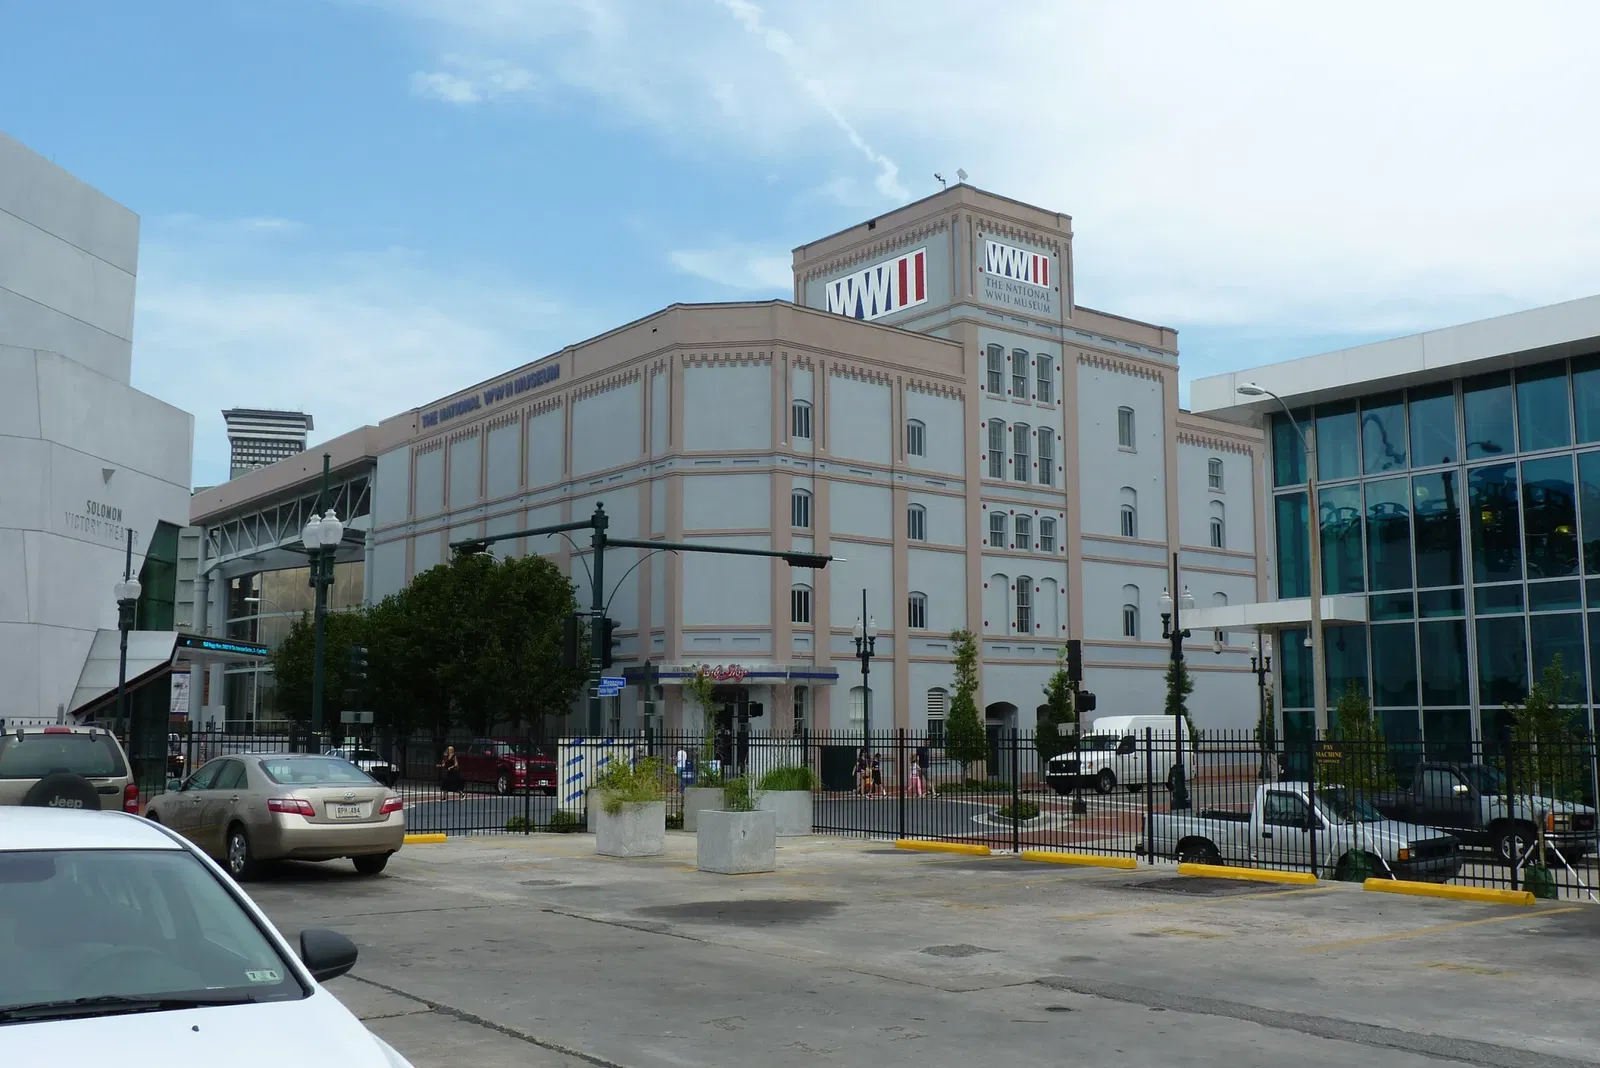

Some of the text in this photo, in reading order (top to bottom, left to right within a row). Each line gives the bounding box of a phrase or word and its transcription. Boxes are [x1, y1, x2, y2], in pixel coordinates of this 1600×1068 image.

[986, 243, 1049, 287] WWII
[827, 251, 926, 319] WWII
[985, 278, 1051, 302] THE NATIONAL
[985, 289, 1051, 314] WWII MUSEUM
[421, 411, 438, 428] THE
[439, 395, 481, 422] NATIONAL
[514, 363, 560, 394] MUSEUM
[86, 499, 122, 522] SOLOMON
[65, 511, 102, 536] VICTORY
[49, 795, 83, 808] Jeep
